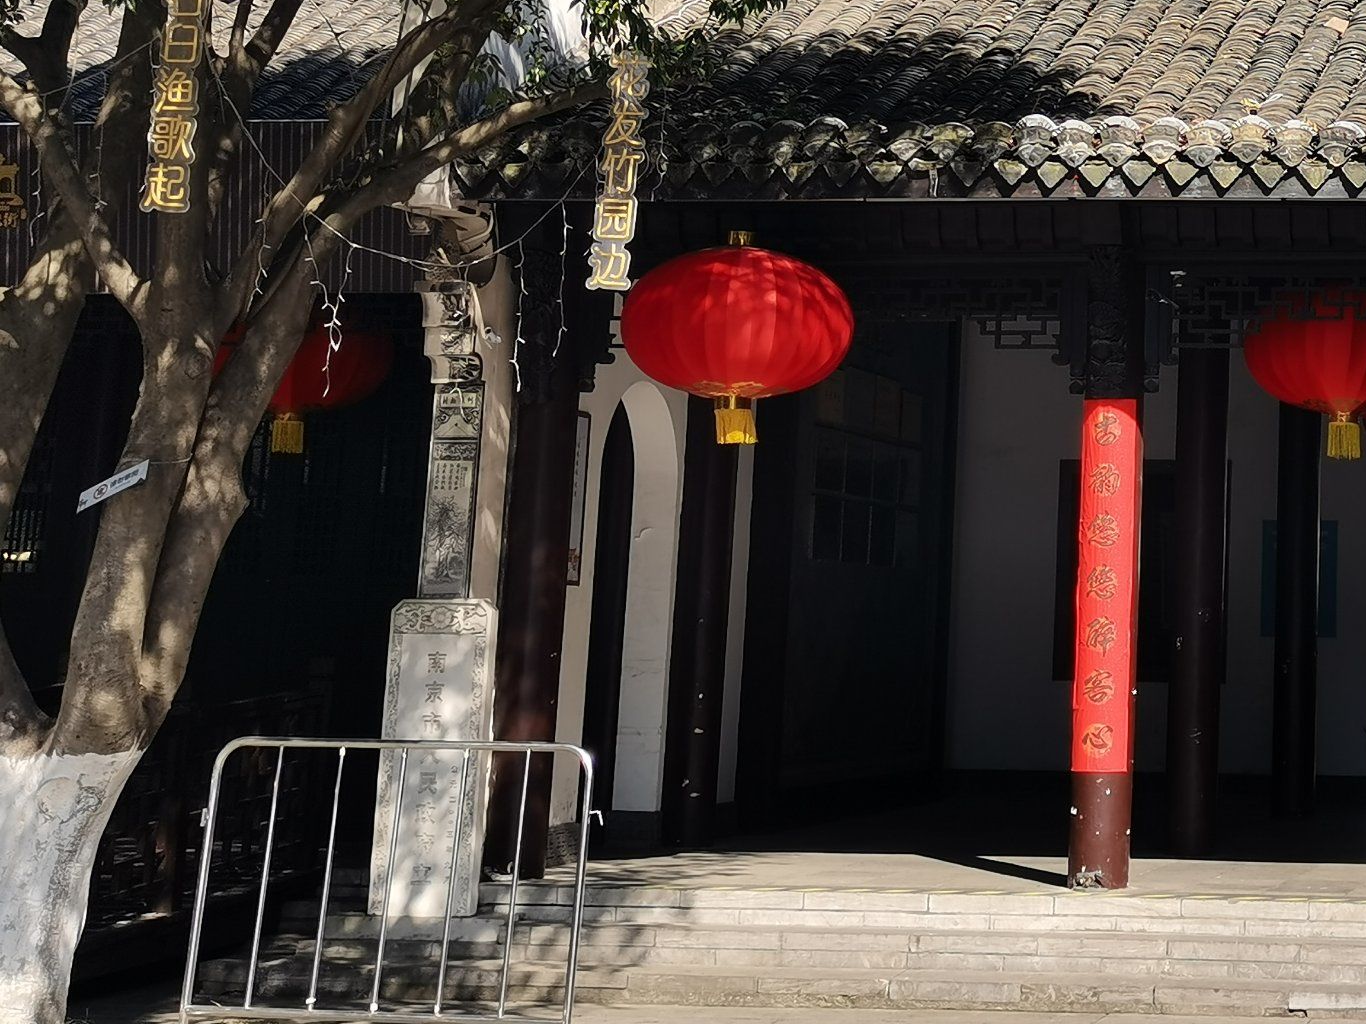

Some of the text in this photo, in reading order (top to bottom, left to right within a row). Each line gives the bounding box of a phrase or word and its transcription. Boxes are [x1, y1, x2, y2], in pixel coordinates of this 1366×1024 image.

[590, 53, 652, 288] 花发竹园边
